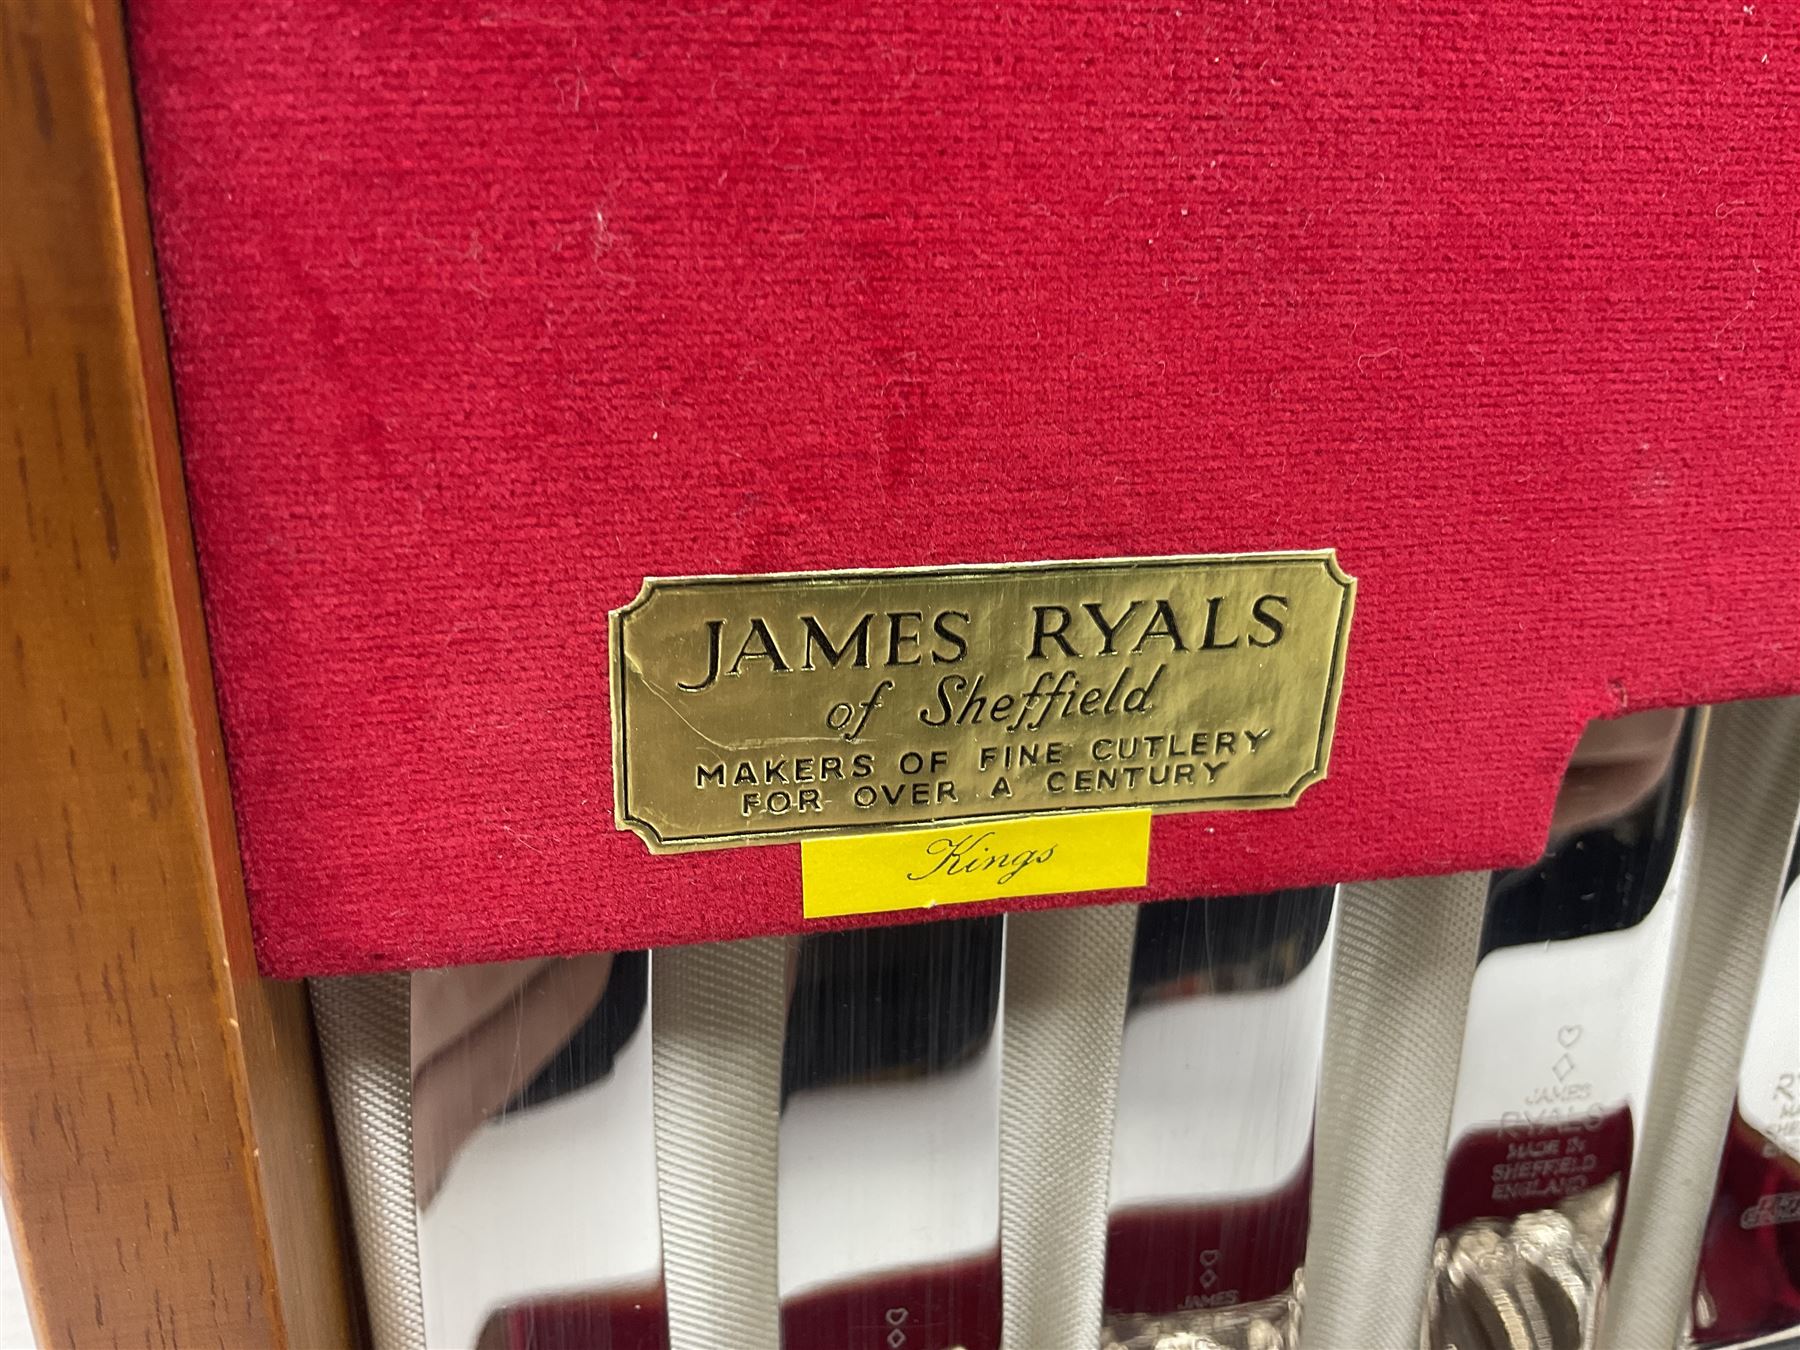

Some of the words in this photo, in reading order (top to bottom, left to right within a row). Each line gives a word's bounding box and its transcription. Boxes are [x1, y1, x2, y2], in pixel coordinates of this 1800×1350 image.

[676, 610, 971, 693] JAMES
[1024, 594, 1289, 661] RYALS
[826, 679, 895, 742] of
[918, 663, 1167, 733] Sheffield
[696, 754, 875, 789] MAKERS
[900, 751, 949, 776] OF
[979, 742, 1063, 772] FINE
[1091, 728, 1272, 762] CUTLERY
[741, 788, 823, 817] FOR
[853, 780, 959, 809] OVER
[990, 776, 1012, 799] A
[1046, 761, 1229, 794] CENTURY
[907, 831, 1059, 884] Kings
